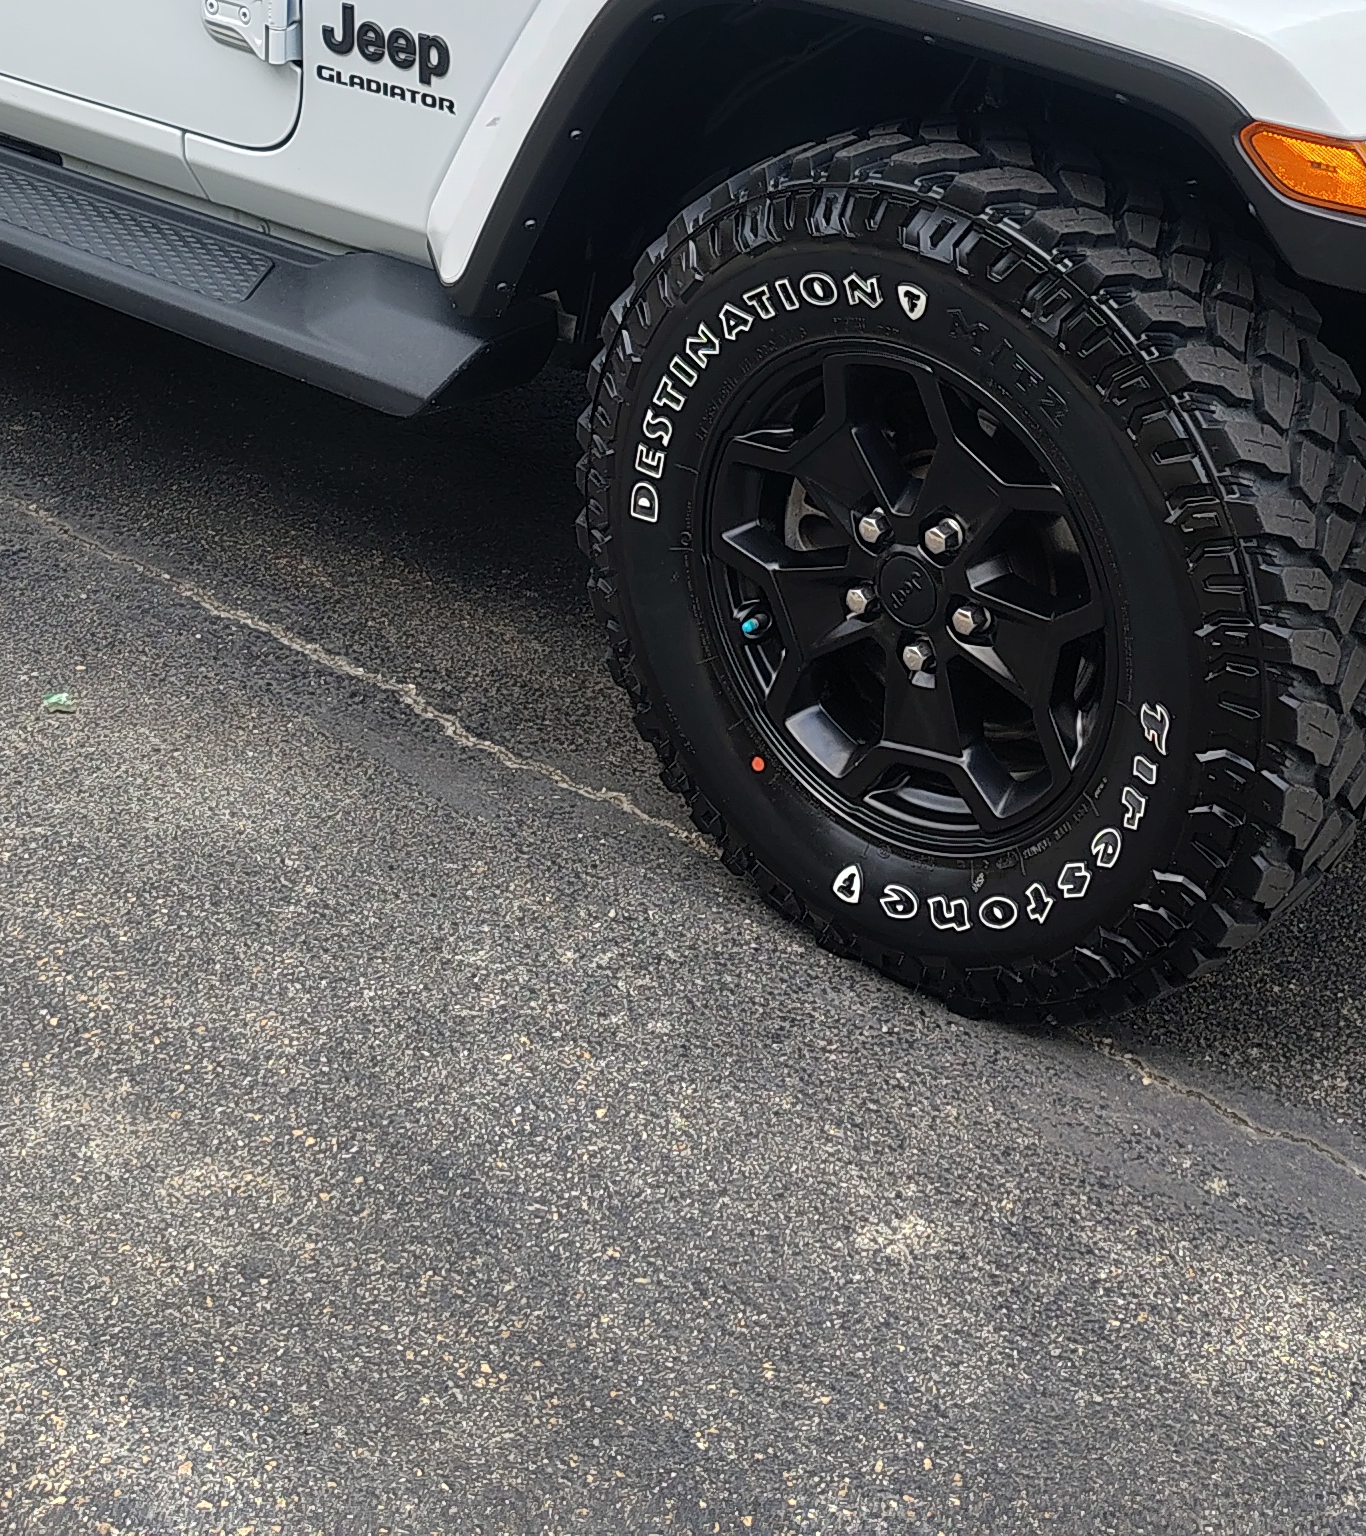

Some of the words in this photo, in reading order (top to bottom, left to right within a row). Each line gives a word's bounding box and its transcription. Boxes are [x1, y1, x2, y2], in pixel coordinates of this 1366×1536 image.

[316, 64, 457, 116] GLADIATOR
[322, 2, 451, 86] Jeep
[630, 271, 883, 523] DESTINATION
[879, 702, 1171, 933] Firestone
